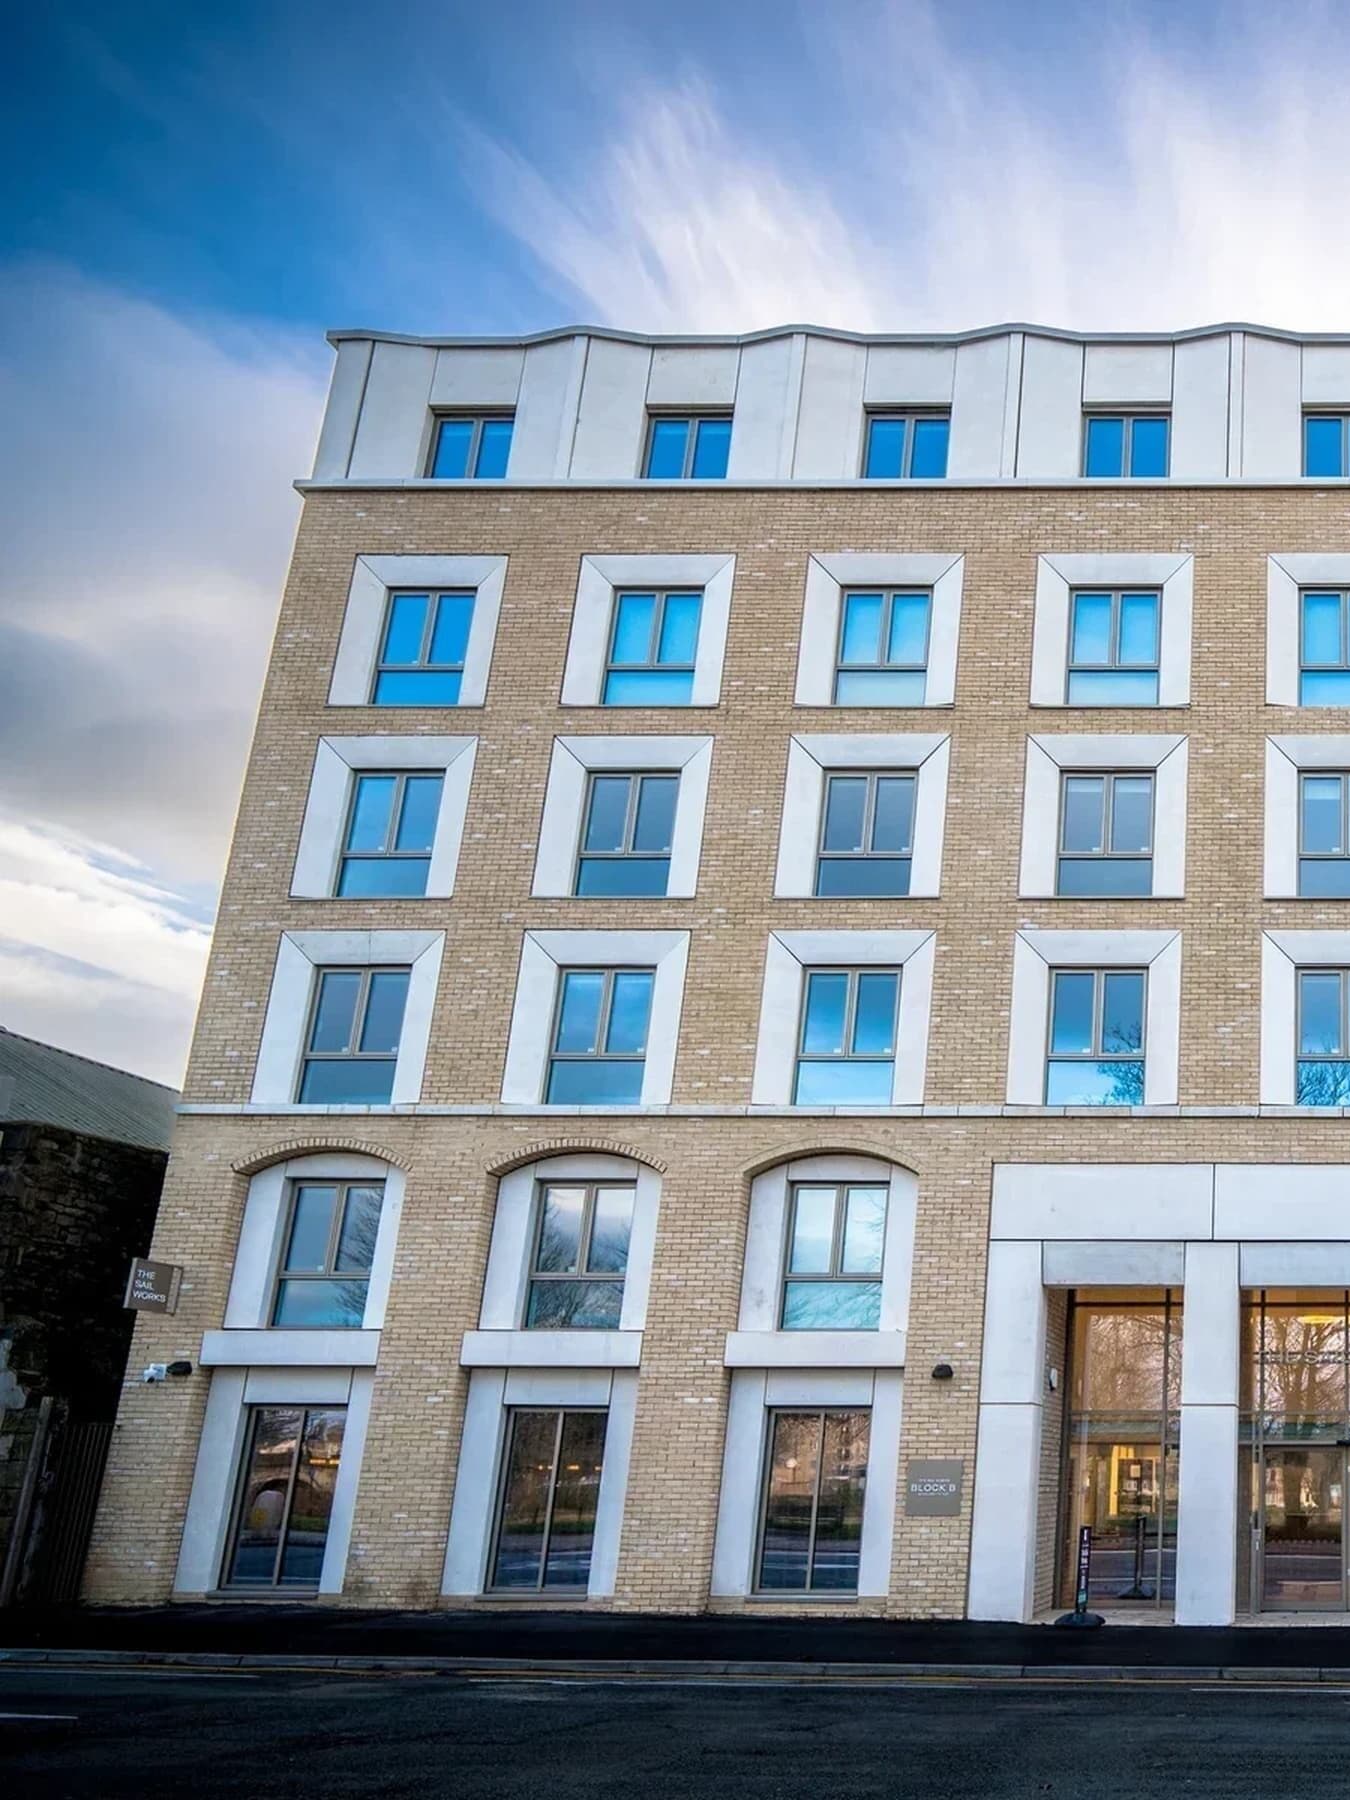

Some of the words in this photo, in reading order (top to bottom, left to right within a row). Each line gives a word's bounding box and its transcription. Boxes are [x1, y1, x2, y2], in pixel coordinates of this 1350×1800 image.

[137, 1269, 156, 1280] THE
[135, 1279, 154, 1291] SAIL
[132, 1290, 166, 1303] WORKS
[1258, 1351, 1299, 1364] THE
[911, 1484, 946, 1492] BLOCK
